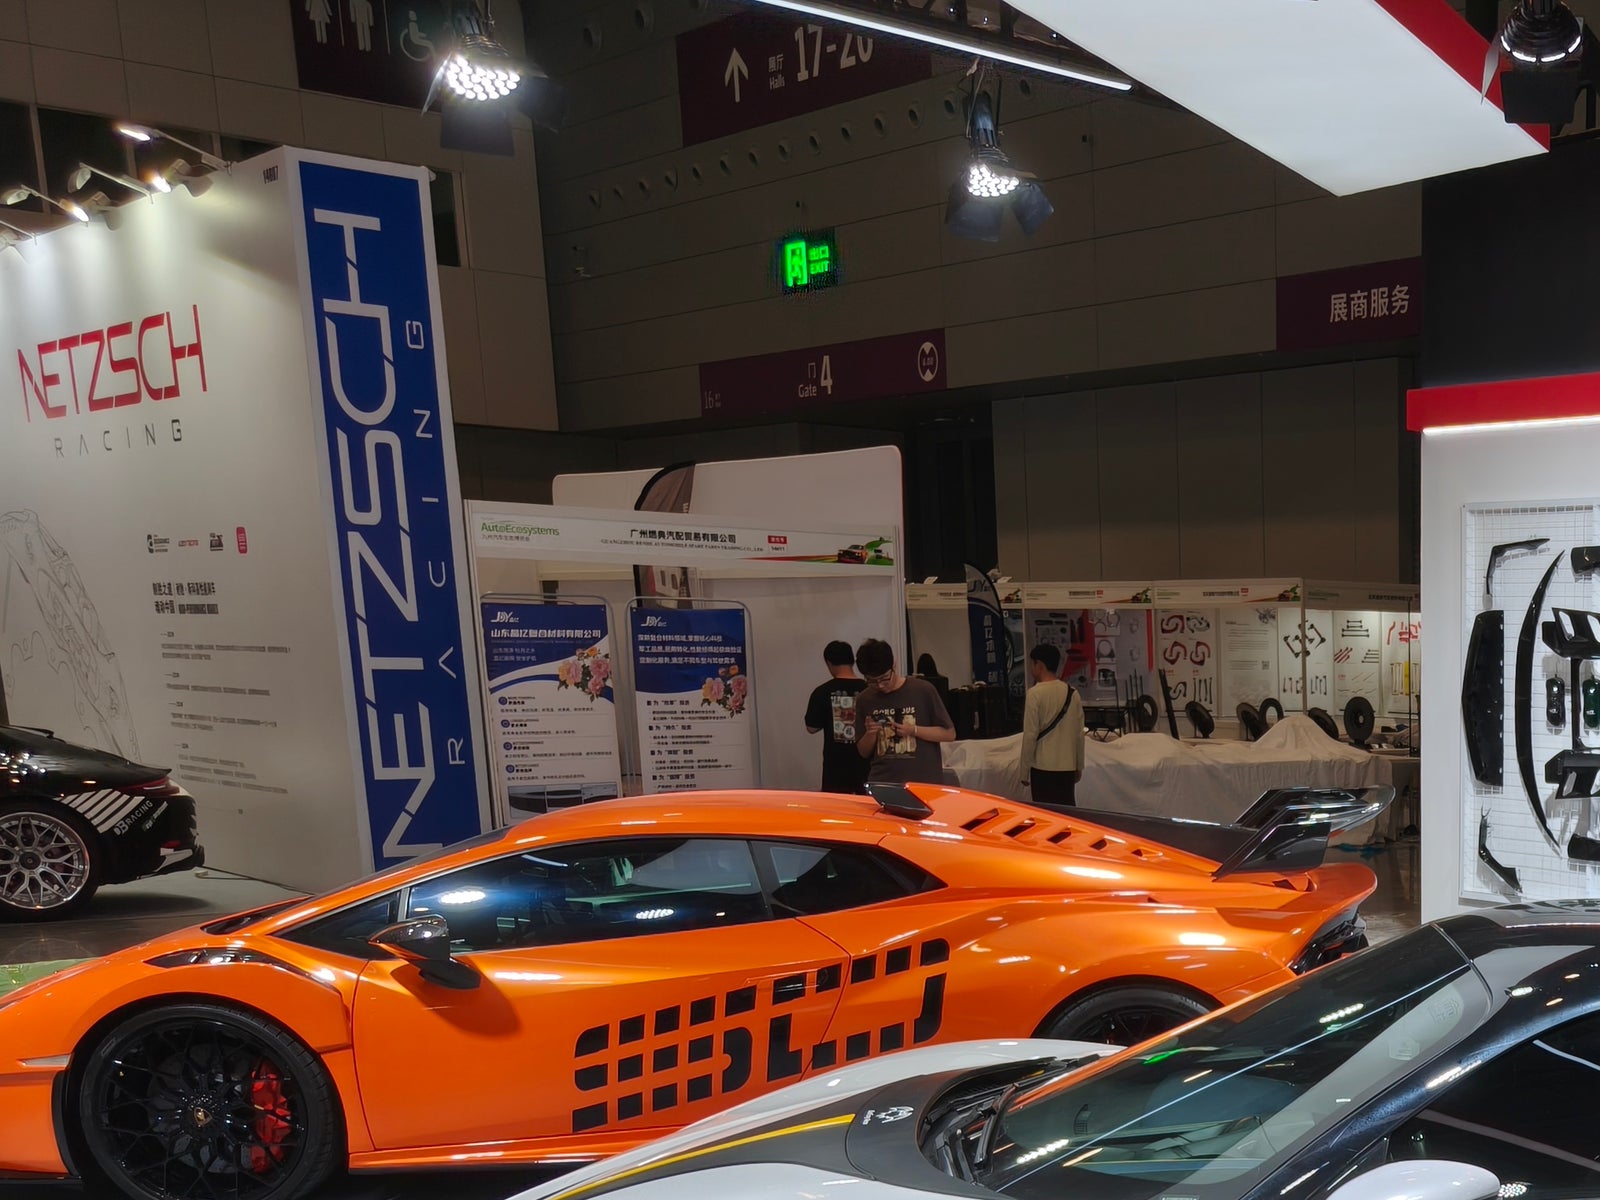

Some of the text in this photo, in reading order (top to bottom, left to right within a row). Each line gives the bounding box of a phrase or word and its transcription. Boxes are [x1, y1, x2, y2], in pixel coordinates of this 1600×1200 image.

[1330, 284, 1410, 323] 展商服务
[17, 304, 207, 423] NETZSCH
[821, 355, 832, 394] 4
[799, 383, 817, 398] Gate
[54, 419, 182, 459] RACING
[313, 207, 444, 858] NETZSCH
[405, 319, 466, 765] RACING
[481, 522, 560, 536] AutoEcosystems
